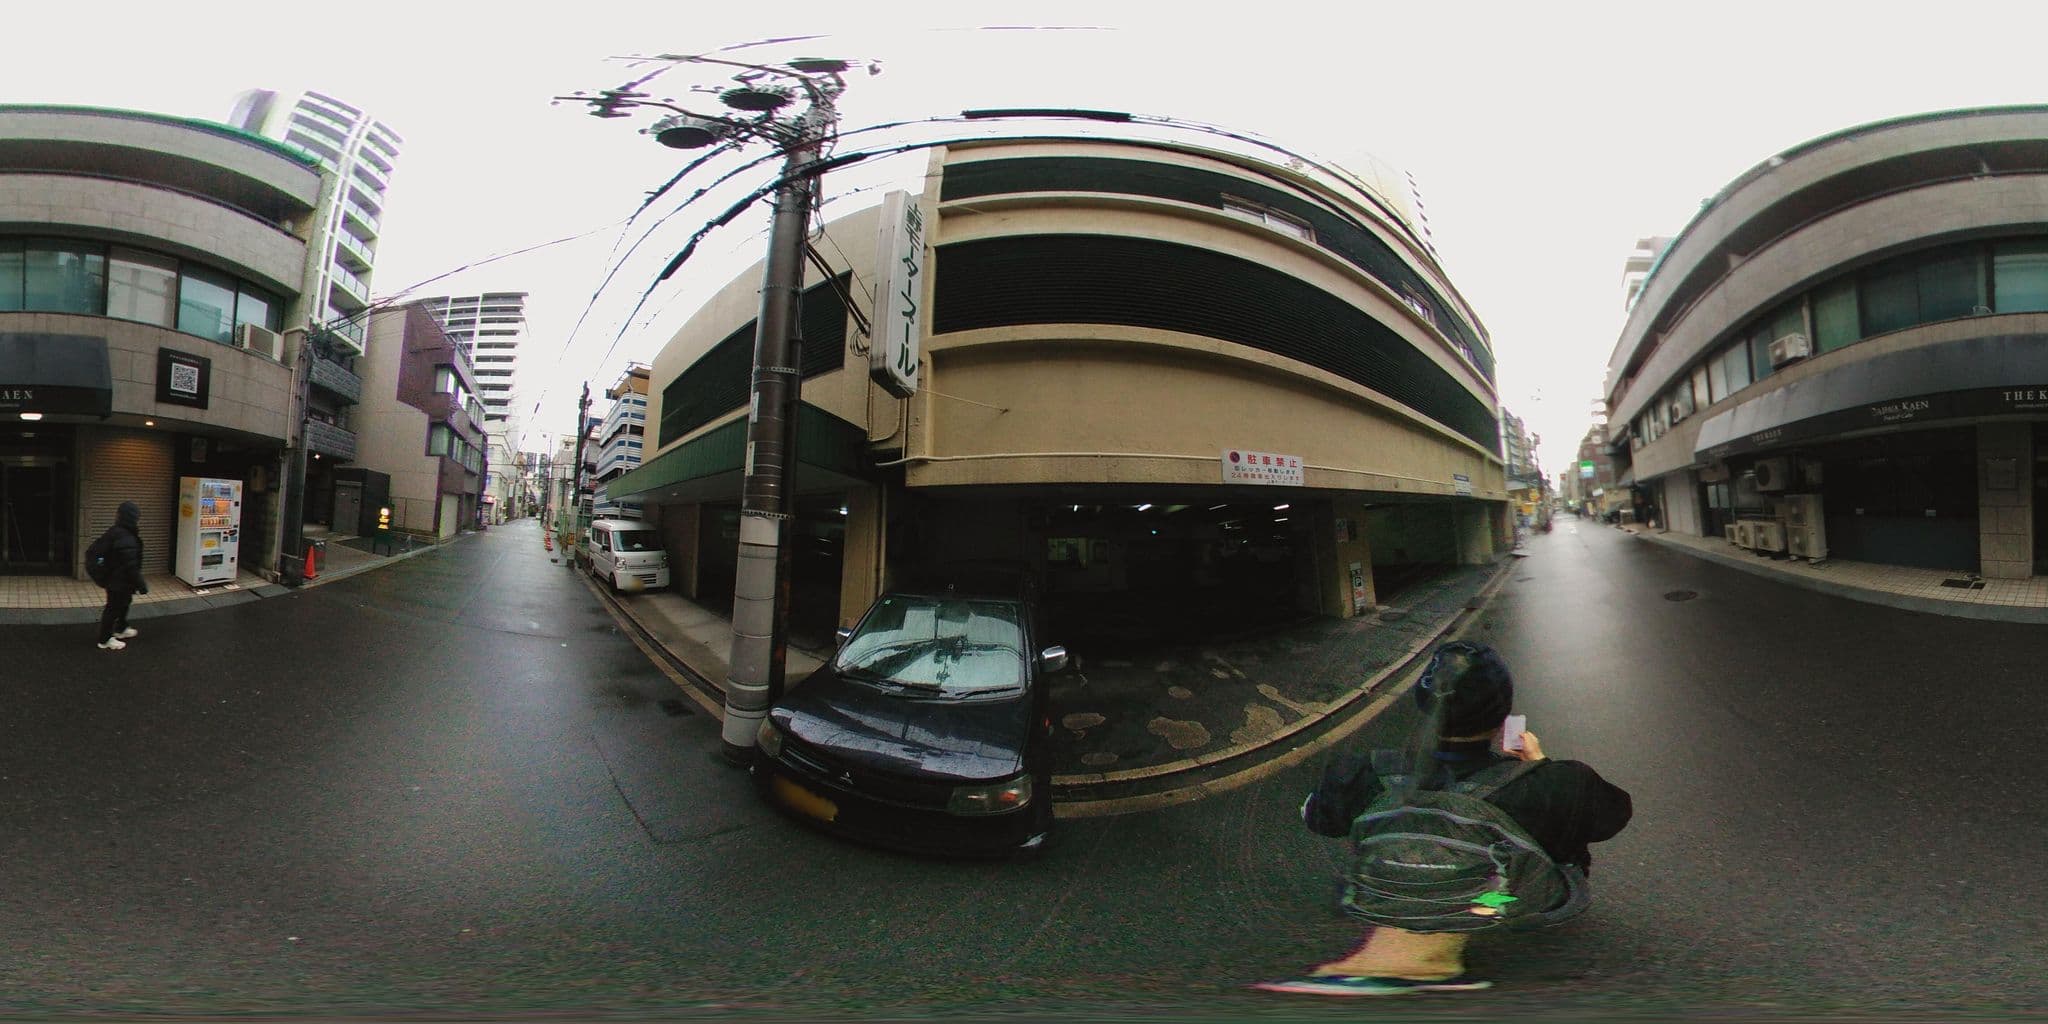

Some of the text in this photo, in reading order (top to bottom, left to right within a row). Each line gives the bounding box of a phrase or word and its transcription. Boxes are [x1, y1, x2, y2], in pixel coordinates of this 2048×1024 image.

[2003, 391, 2034, 401] THE
[1902, 400, 1929, 410] KAEN
[1247, 454, 1297, 468] 駐車禁止
